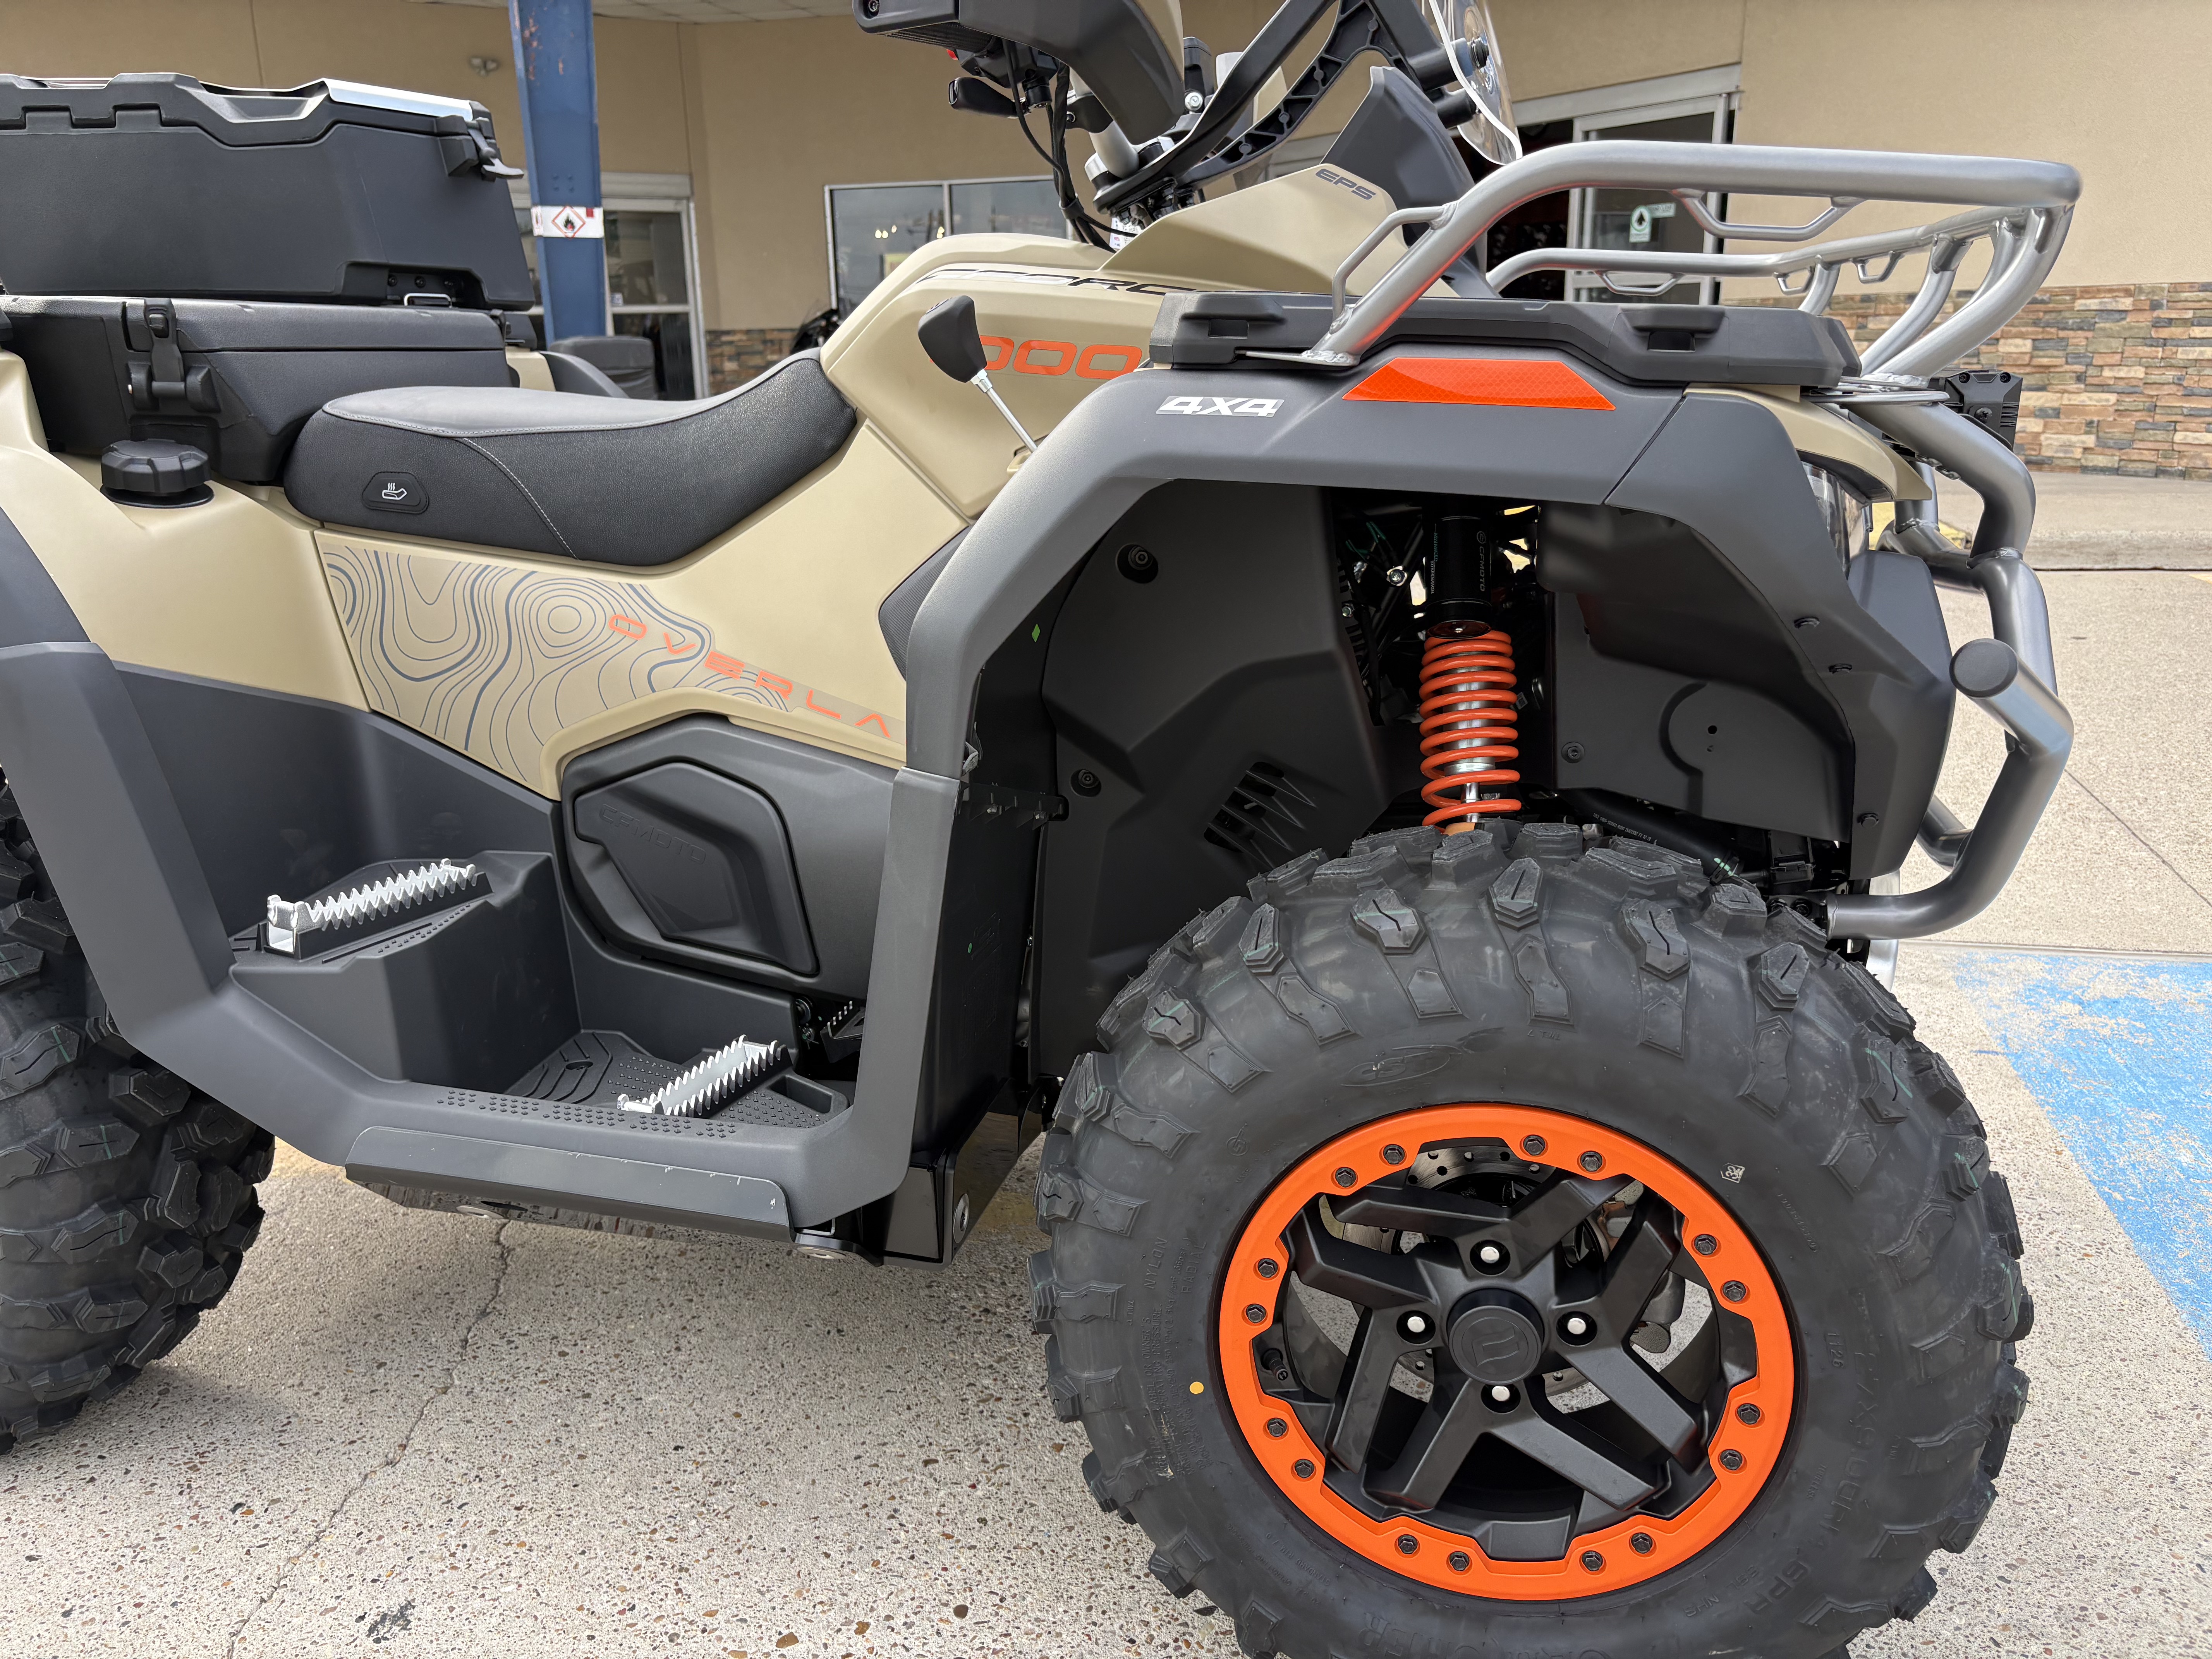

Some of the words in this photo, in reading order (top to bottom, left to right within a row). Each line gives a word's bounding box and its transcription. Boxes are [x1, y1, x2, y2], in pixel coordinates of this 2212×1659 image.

[1316, 168, 1376, 200] EPS
[915, 269, 1197, 296] CFORC
[930, 335, 1142, 379] 000
[1159, 397, 1278, 417] 4X4
[608, 614, 907, 744] OVERLA
[599, 804, 707, 865] CFMOTO
[1347, 1044, 1450, 1084] CST
[1144, 1237, 1168, 1289] NYLON
[1181, 1242, 1206, 1293] RADIAL
[1142, 1317, 1151, 1358] OWNER'S
[1826, 1332, 1845, 1369] 1126
[1143, 1364, 1152, 1376] OR
[1164, 1348, 1173, 1364] 250
[1146, 1382, 1160, 1412] LABEL
[1153, 1360, 1170, 1414] OPERATING
[1167, 1369, 1178, 1398] BEYOND
[1164, 1417, 1178, 1436] FOR
[1174, 1403, 1191, 1436] INFLATE
[1184, 1407, 1202, 1443] SEATING
[1173, 1439, 1196, 1475] MANUAL
[1185, 1438, 1200, 1456] NOT
[1197, 1444, 1214, 1466] WHEN
[1194, 1457, 1207, 1470] DO
[1227, 1523, 1255, 1553] PRESSURE
[1279, 1545, 1295, 1559] RIM
[1255, 1554, 1291, 1586] OPERATING
[1296, 1558, 1331, 1586] STANDARD
[1743, 1559, 1811, 1614] 6PR
[1684, 1594, 1720, 1617] NHS
